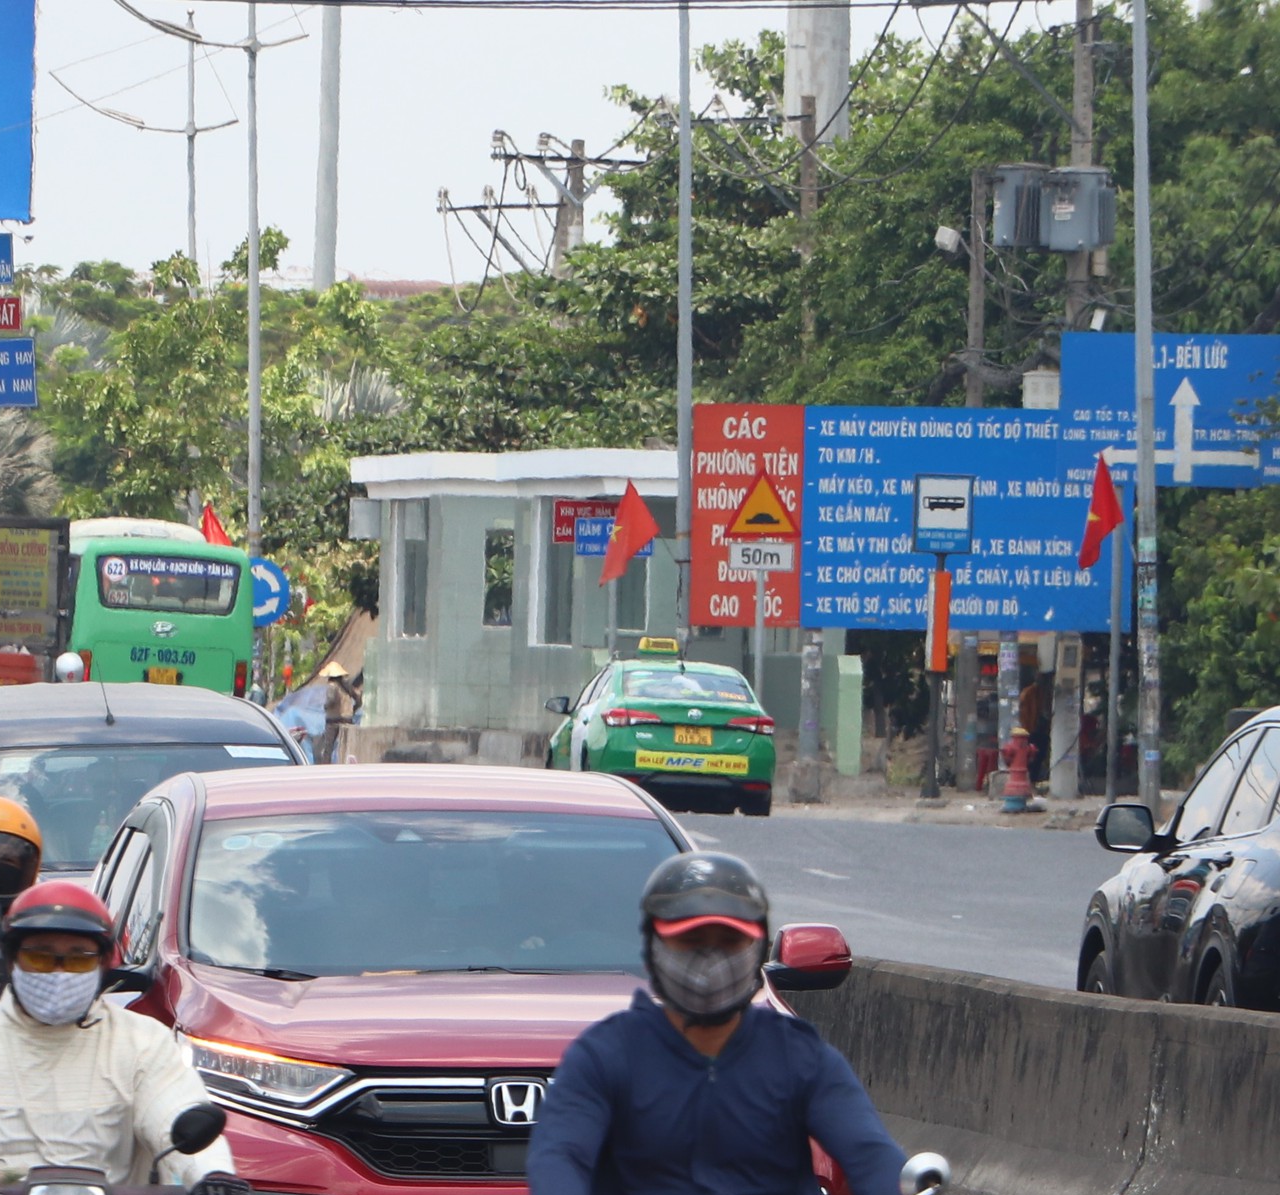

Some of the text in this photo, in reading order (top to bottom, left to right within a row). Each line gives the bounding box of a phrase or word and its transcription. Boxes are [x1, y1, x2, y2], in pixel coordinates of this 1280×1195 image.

[15, 351, 33, 365] HAY
[722, 411, 767, 440] CÁC
[820, 420, 835, 436] XE
[839, 413, 866, 437] MÁY
[868, 416, 917, 437] CHUYÊN
[955, 418, 973, 439] CÓ
[977, 416, 1001, 439] TỐC
[1024, 416, 1060, 440] THIẾT
[697, 446, 799, 480] PHƯƠNG TIỆN
[818, 447, 833, 464] 70
[818, 473, 846, 494] MÁY
[882, 479, 898, 494] XE
[1007, 480, 1022, 497] XE
[818, 506, 833, 522] XE
[741, 547, 781, 565] 50m
[817, 536, 834, 553] XE
[868, 537, 888, 553] THI
[990, 538, 1005, 555] XE
[1008, 536, 1041, 556] BÁNH
[107, 563, 124, 575] 622
[817, 566, 833, 583] XE
[864, 560, 896, 584] CHẤT
[710, 594, 739, 617] CAO
[816, 597, 833, 614] XE
[888, 592, 912, 615] SÚC
[665, 757, 705, 767] MPE
